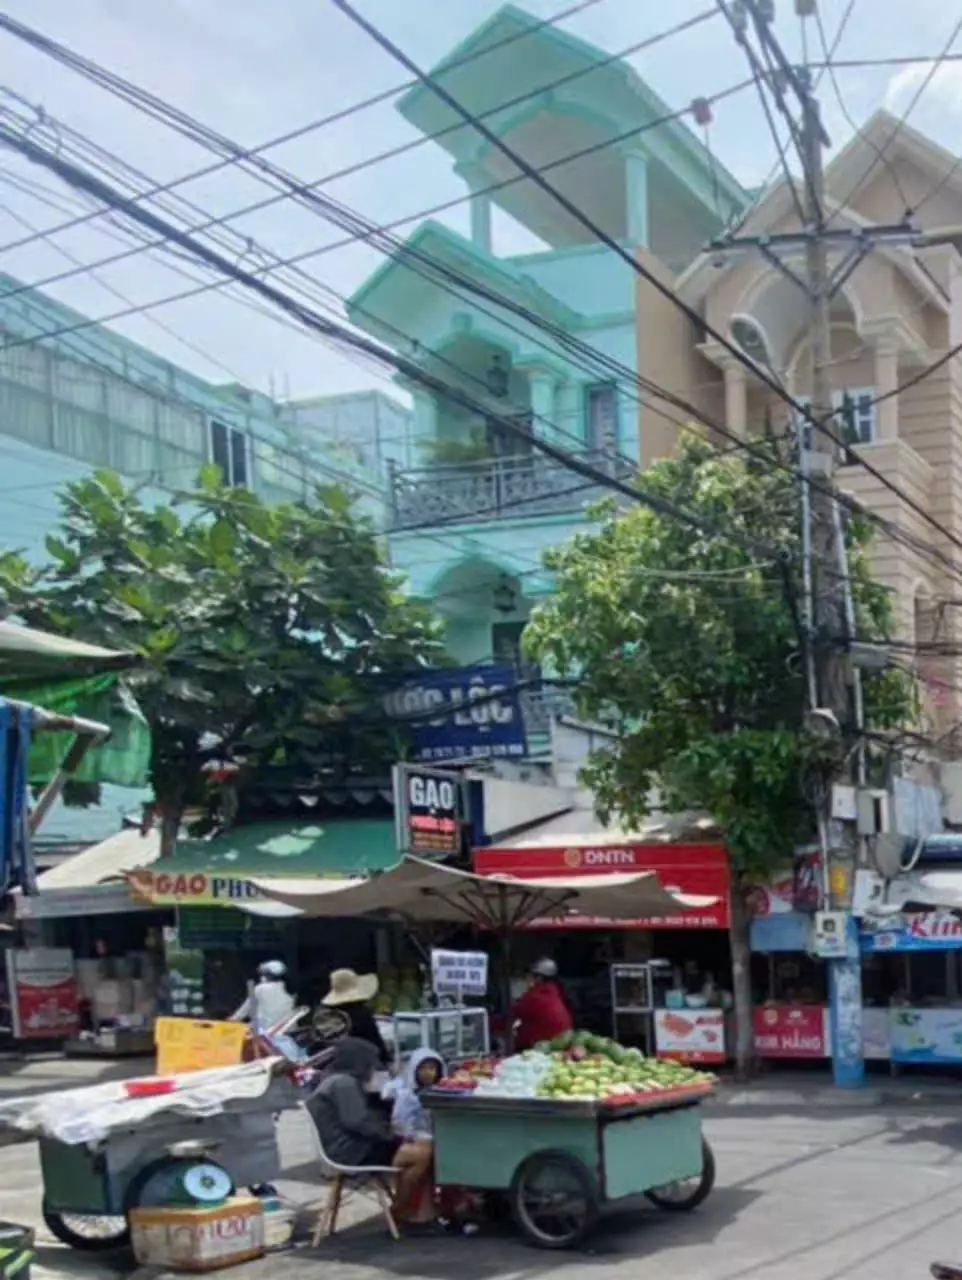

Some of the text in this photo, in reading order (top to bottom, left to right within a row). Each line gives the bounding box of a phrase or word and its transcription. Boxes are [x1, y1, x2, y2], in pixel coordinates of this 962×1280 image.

[409, 776, 455, 815] GẠO
[585, 850, 634, 865] DNTN
[154, 873, 208, 901] GẠO
